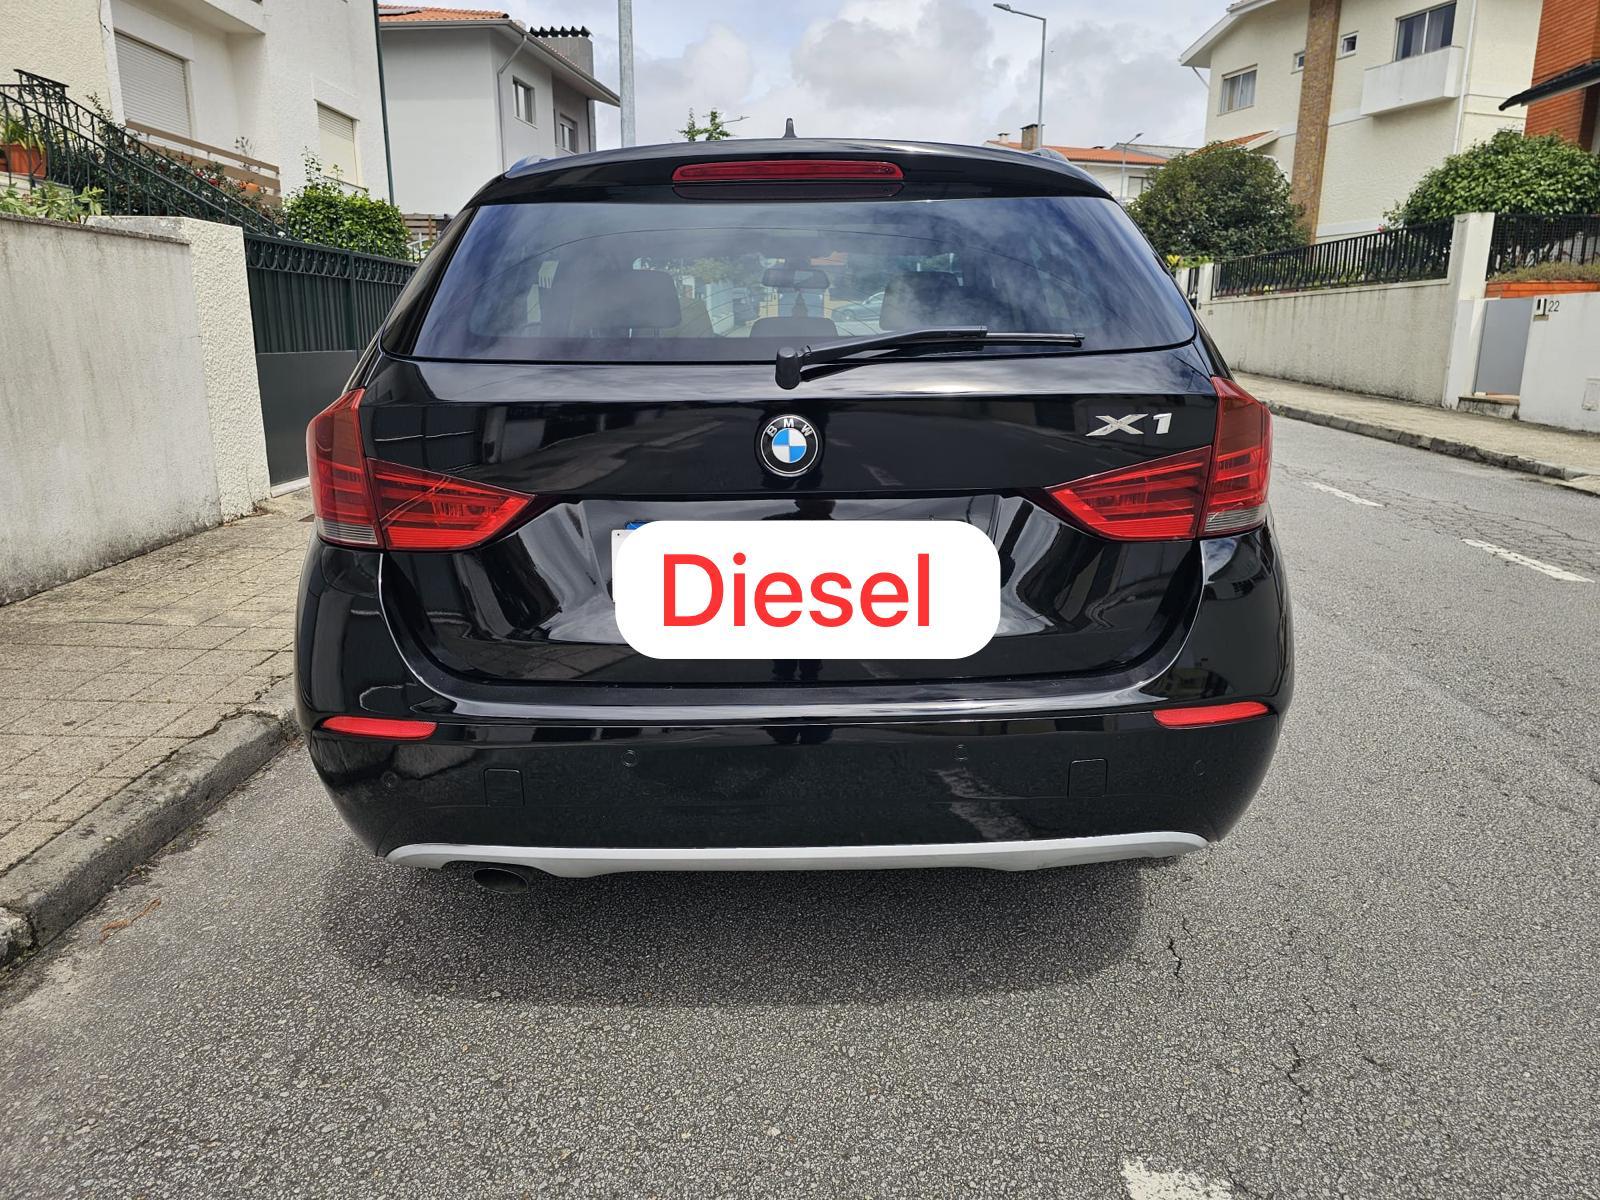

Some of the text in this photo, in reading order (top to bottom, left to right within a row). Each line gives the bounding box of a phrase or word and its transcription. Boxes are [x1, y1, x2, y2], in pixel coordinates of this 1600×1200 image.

[1548, 300, 1560, 312] 22
[766, 418, 813, 438] BMW
[1085, 412, 1172, 437] X1
